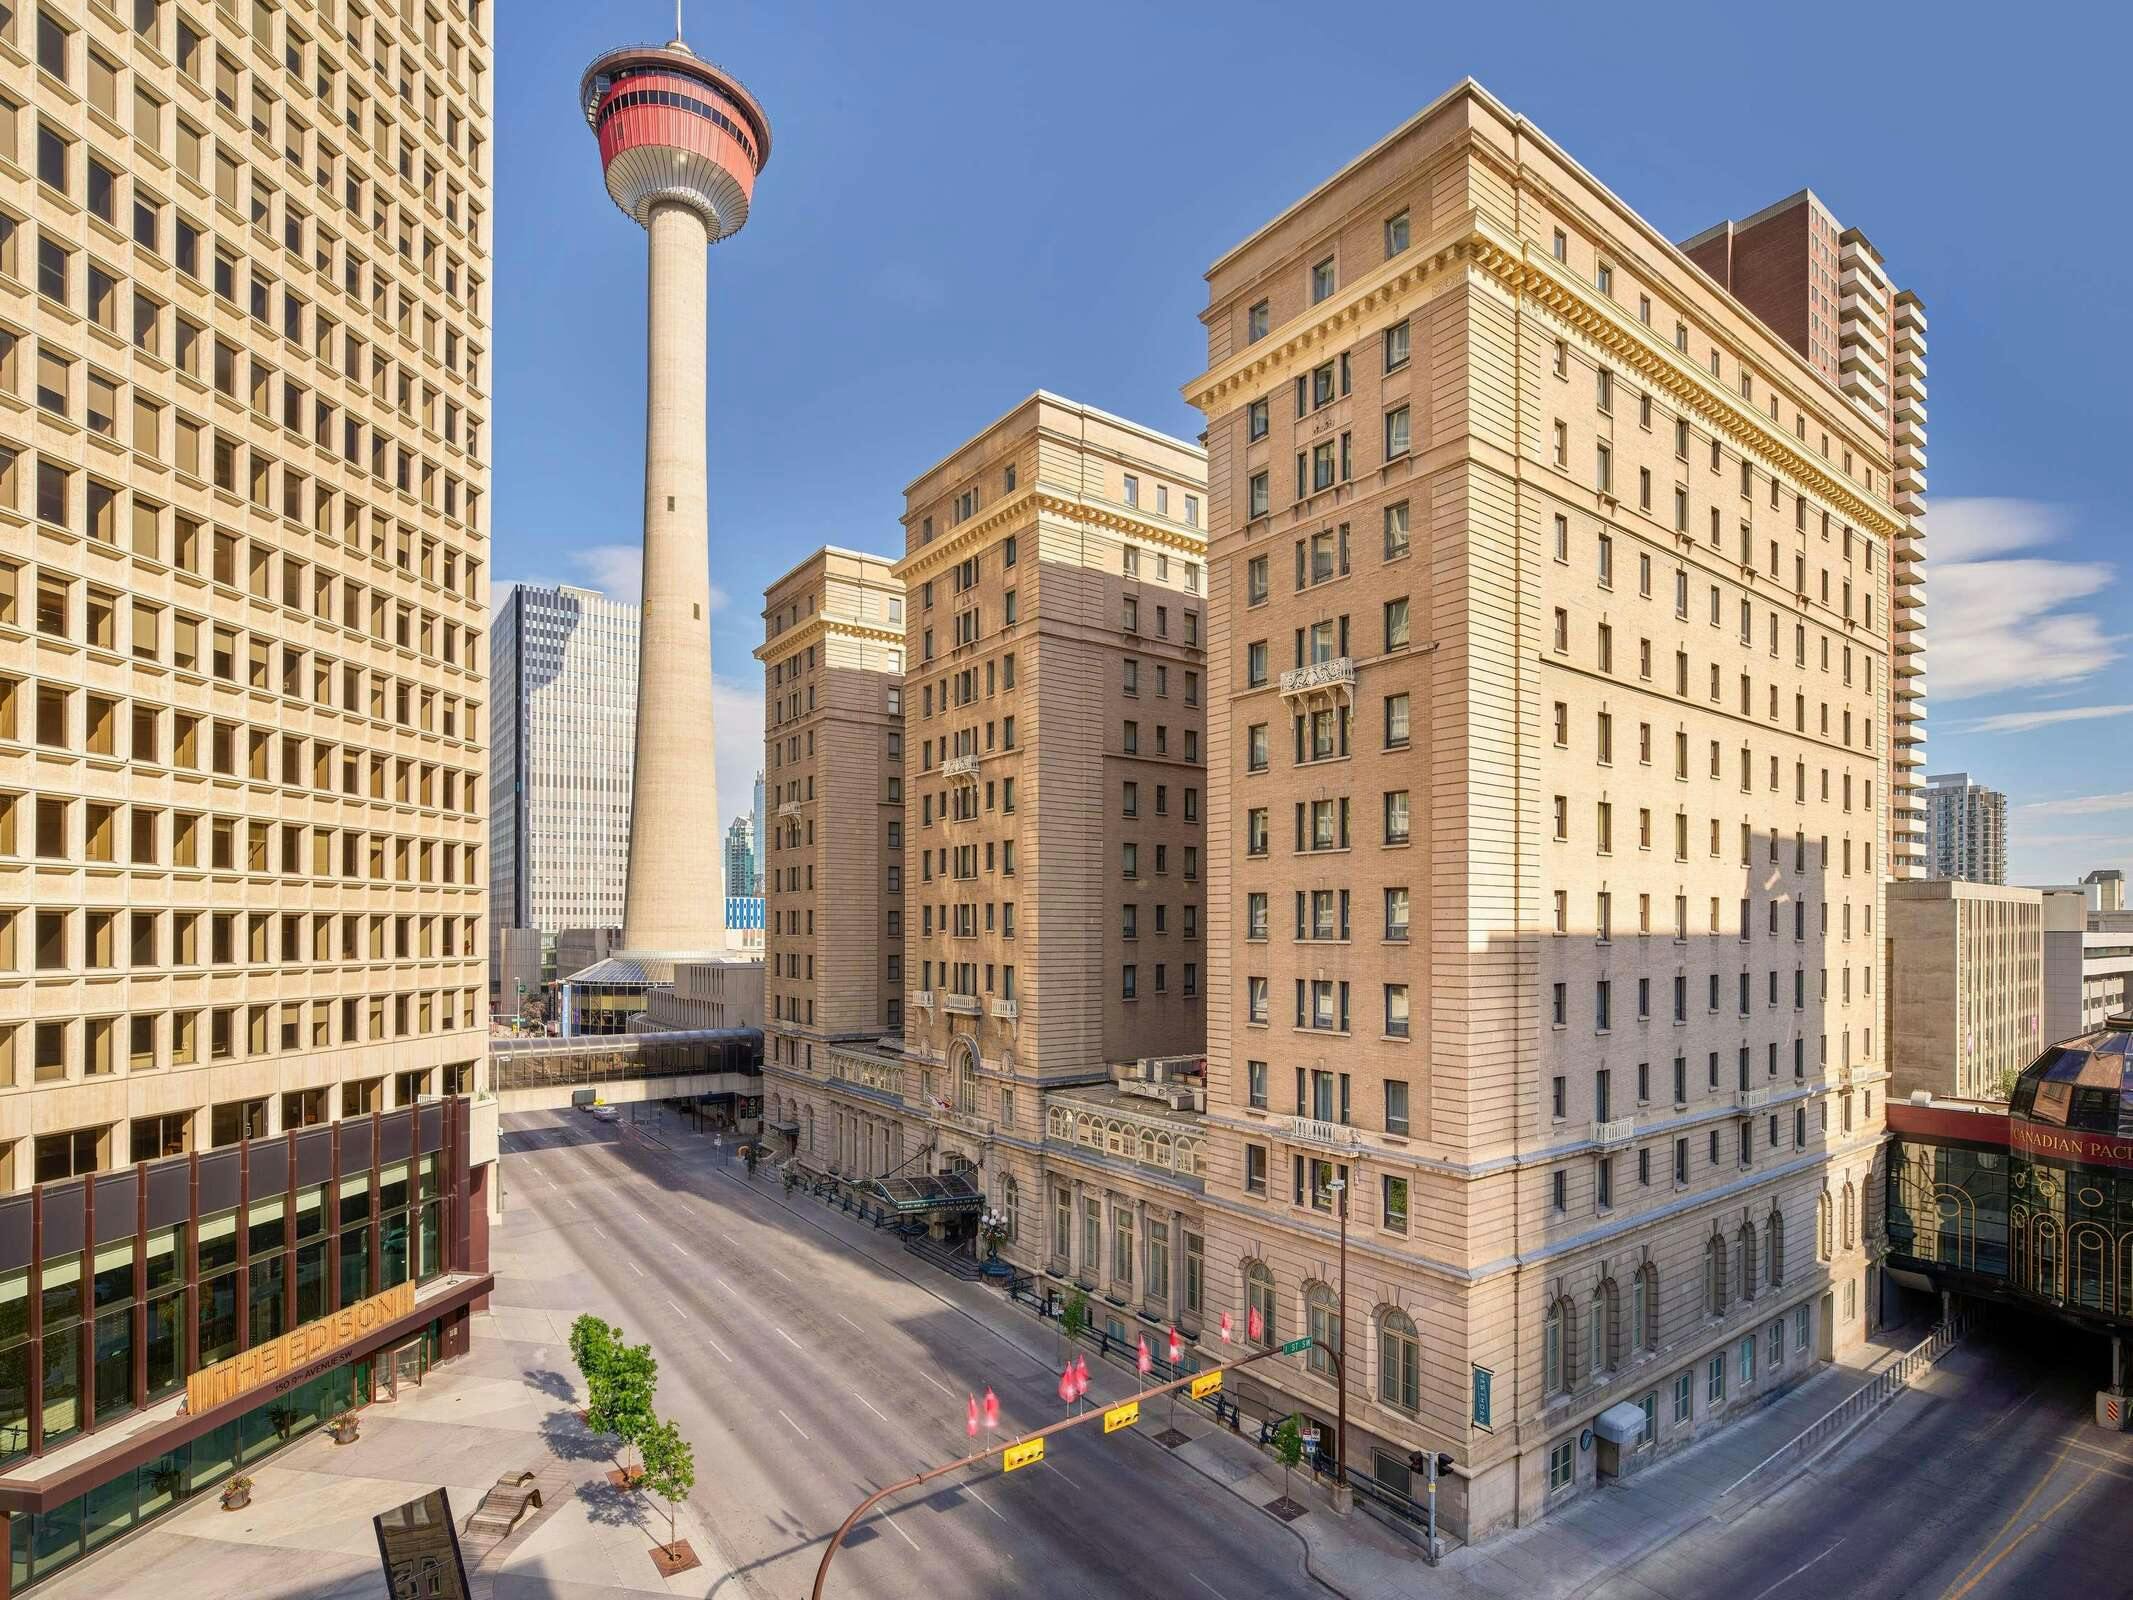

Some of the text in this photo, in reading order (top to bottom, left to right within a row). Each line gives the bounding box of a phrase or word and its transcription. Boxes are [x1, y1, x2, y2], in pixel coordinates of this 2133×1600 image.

[2013, 1127, 2084, 1154] CANADIAN
[215, 1293, 394, 1397] THE EDISON
[1291, 1342, 1299, 1351] ST
[1302, 1339, 1311, 1348] SW
[275, 1381, 290, 1393] 150
[304, 1357, 339, 1378] AVENUE
[340, 1349, 353, 1361] SW
